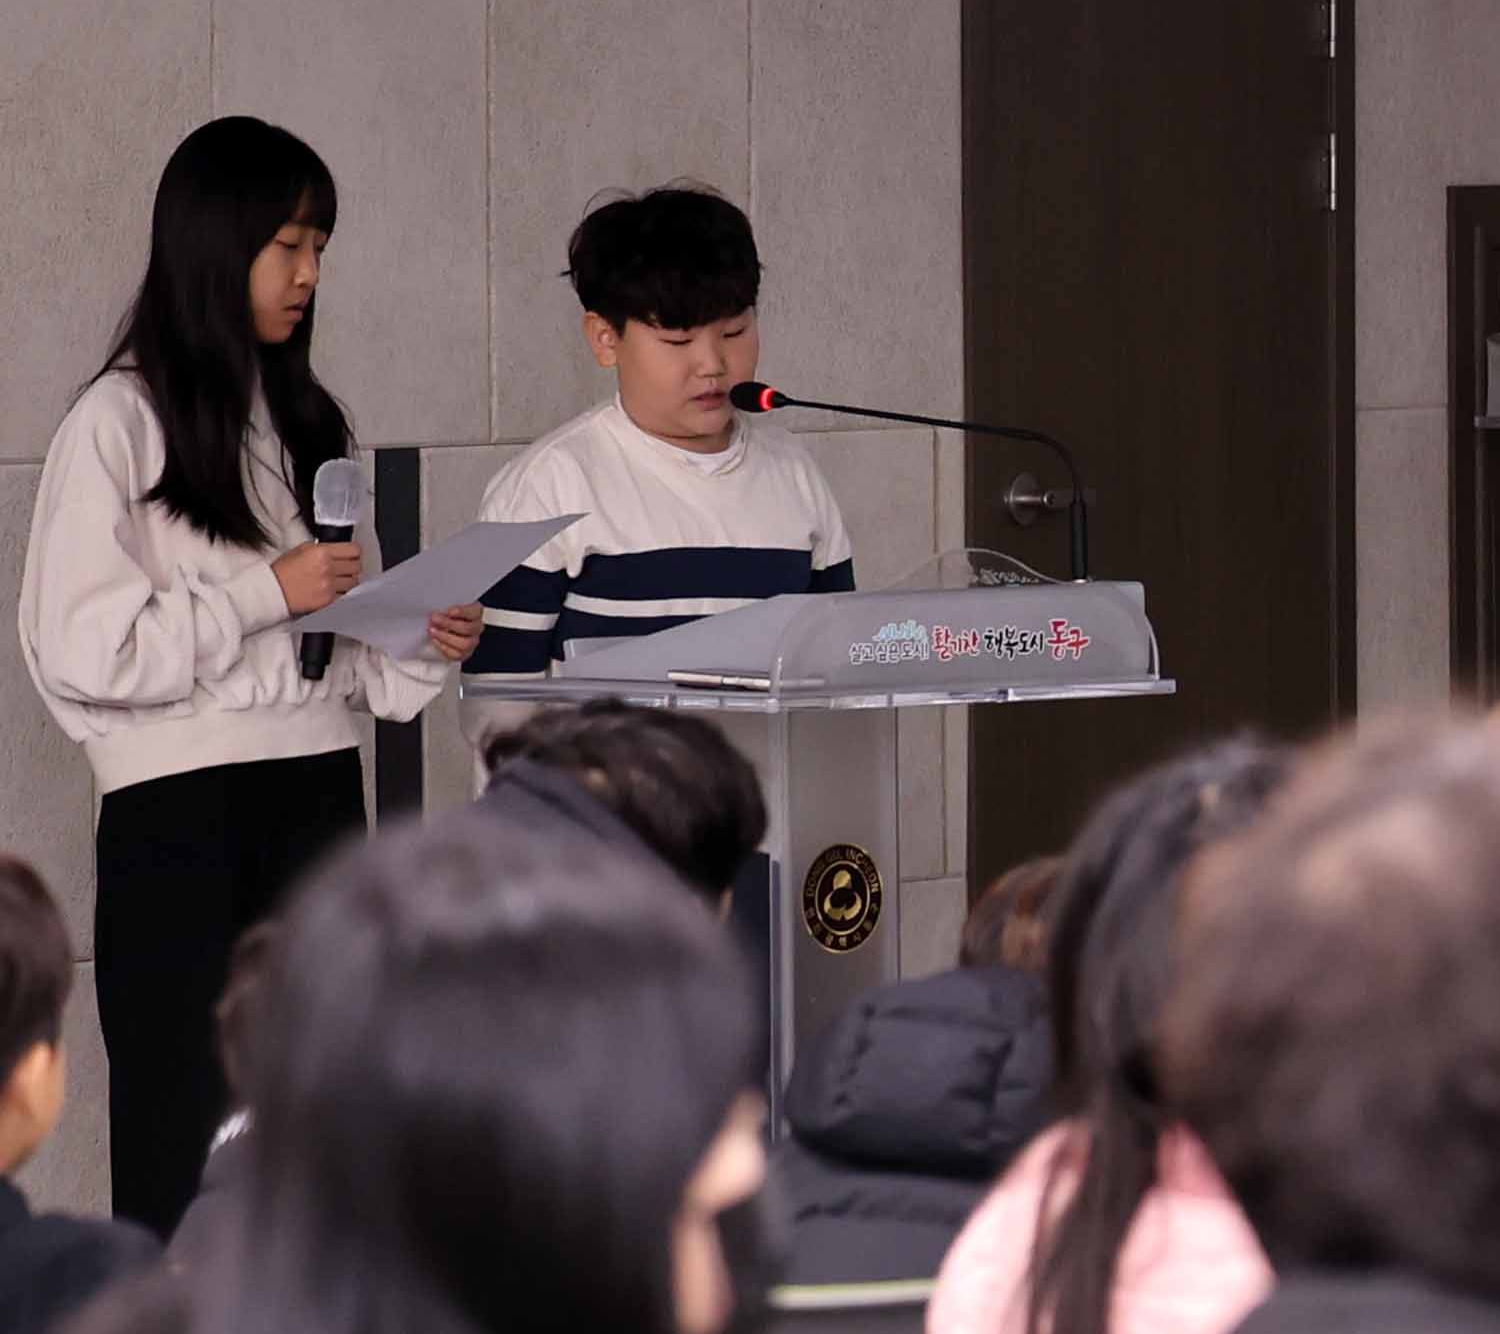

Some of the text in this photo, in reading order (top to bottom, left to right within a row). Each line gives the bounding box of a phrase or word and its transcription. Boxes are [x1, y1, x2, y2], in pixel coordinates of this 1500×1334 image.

[850, 619, 1089, 663] 살고 싶은 도시! 활기찬 행복도시 동구
